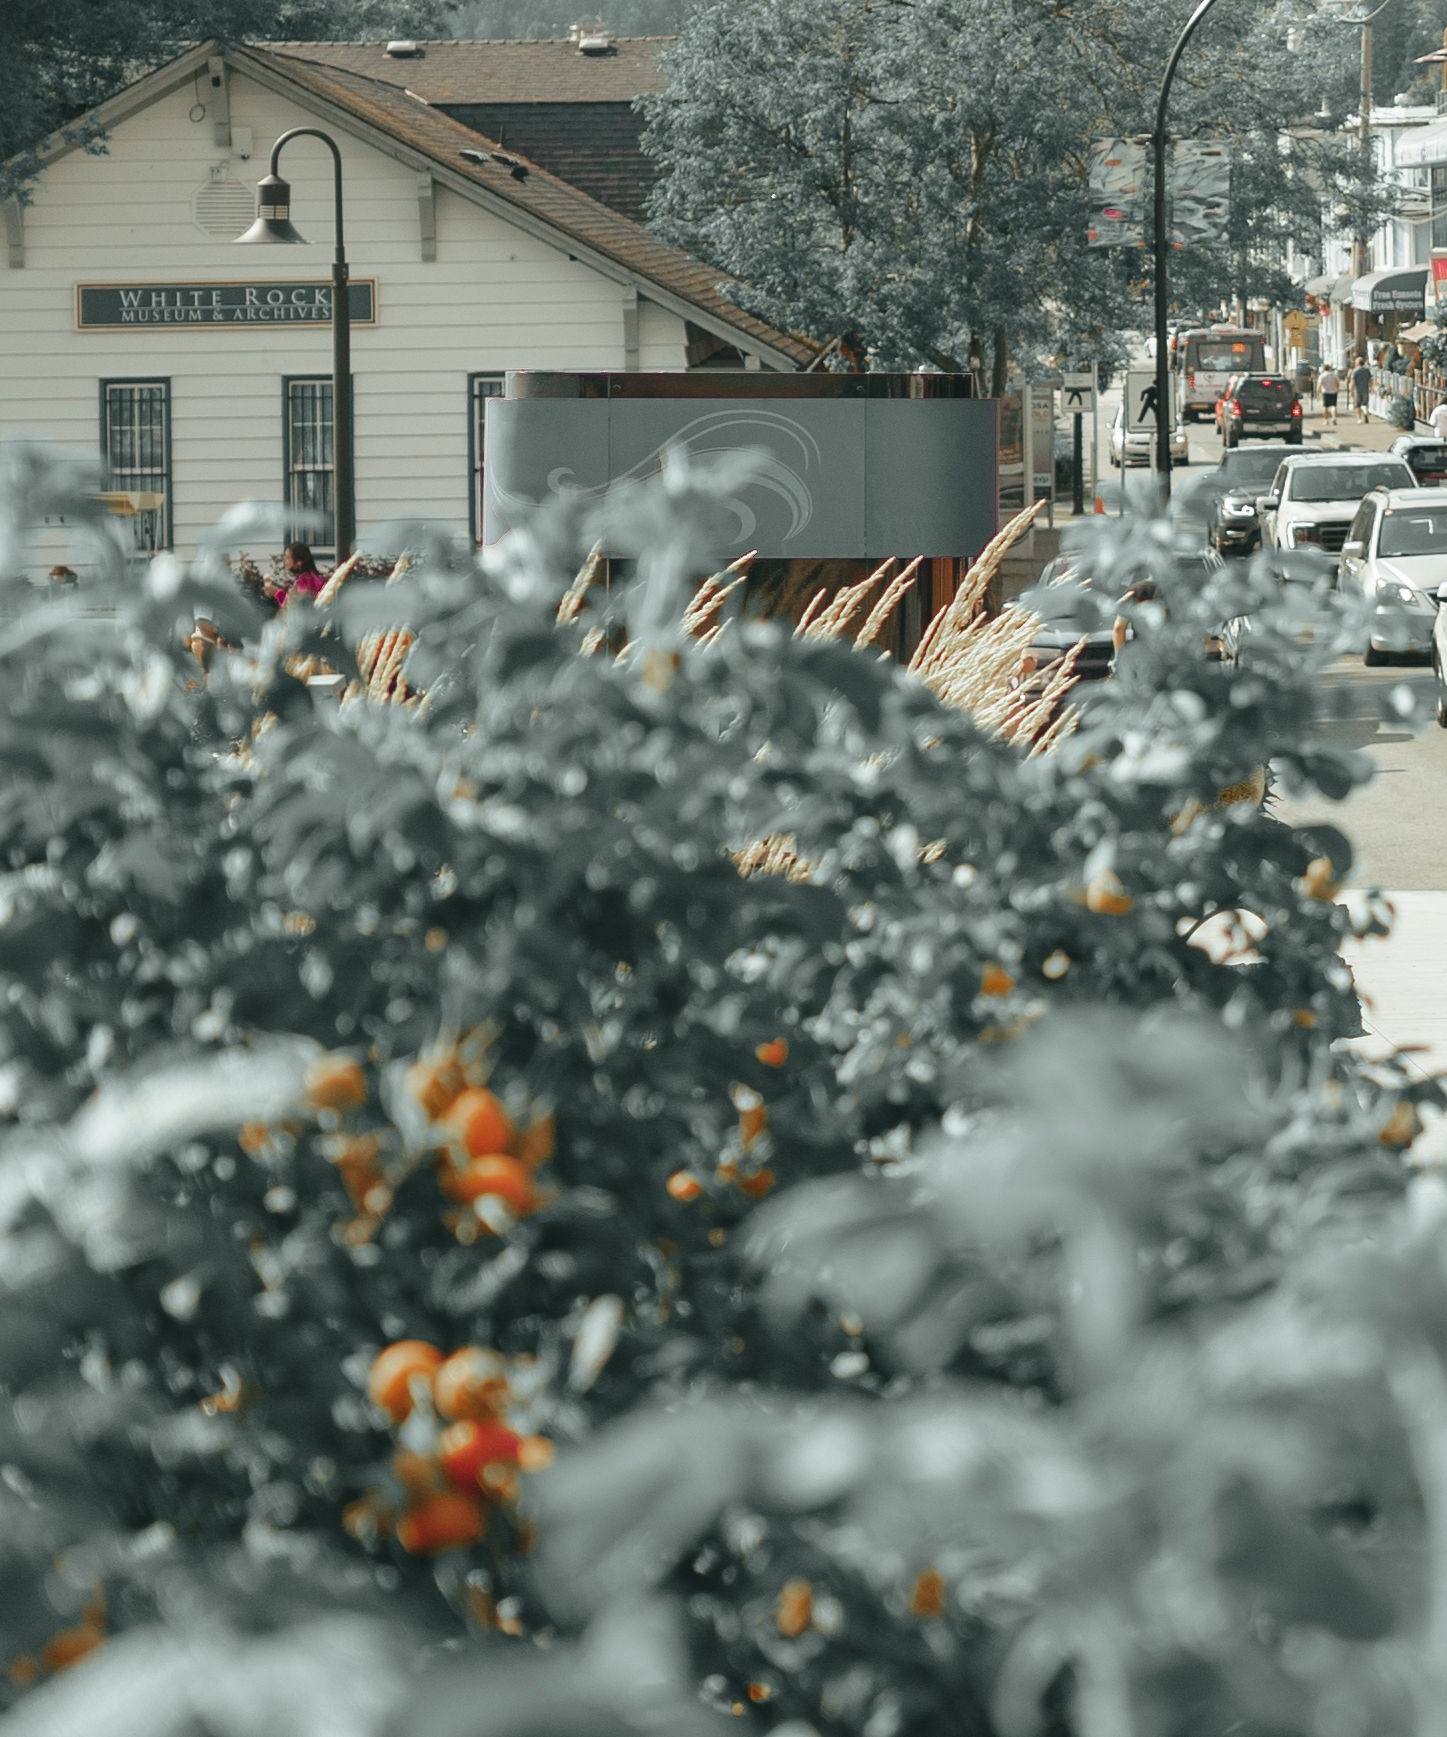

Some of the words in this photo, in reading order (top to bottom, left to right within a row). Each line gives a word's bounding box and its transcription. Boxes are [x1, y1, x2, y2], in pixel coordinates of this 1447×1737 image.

[119, 289, 222, 308] WHITE
[244, 287, 332, 306] ROCK
[120, 308, 202, 323] MUSEUM
[212, 308, 224, 321] &
[232, 306, 331, 321] ARCHIVES
